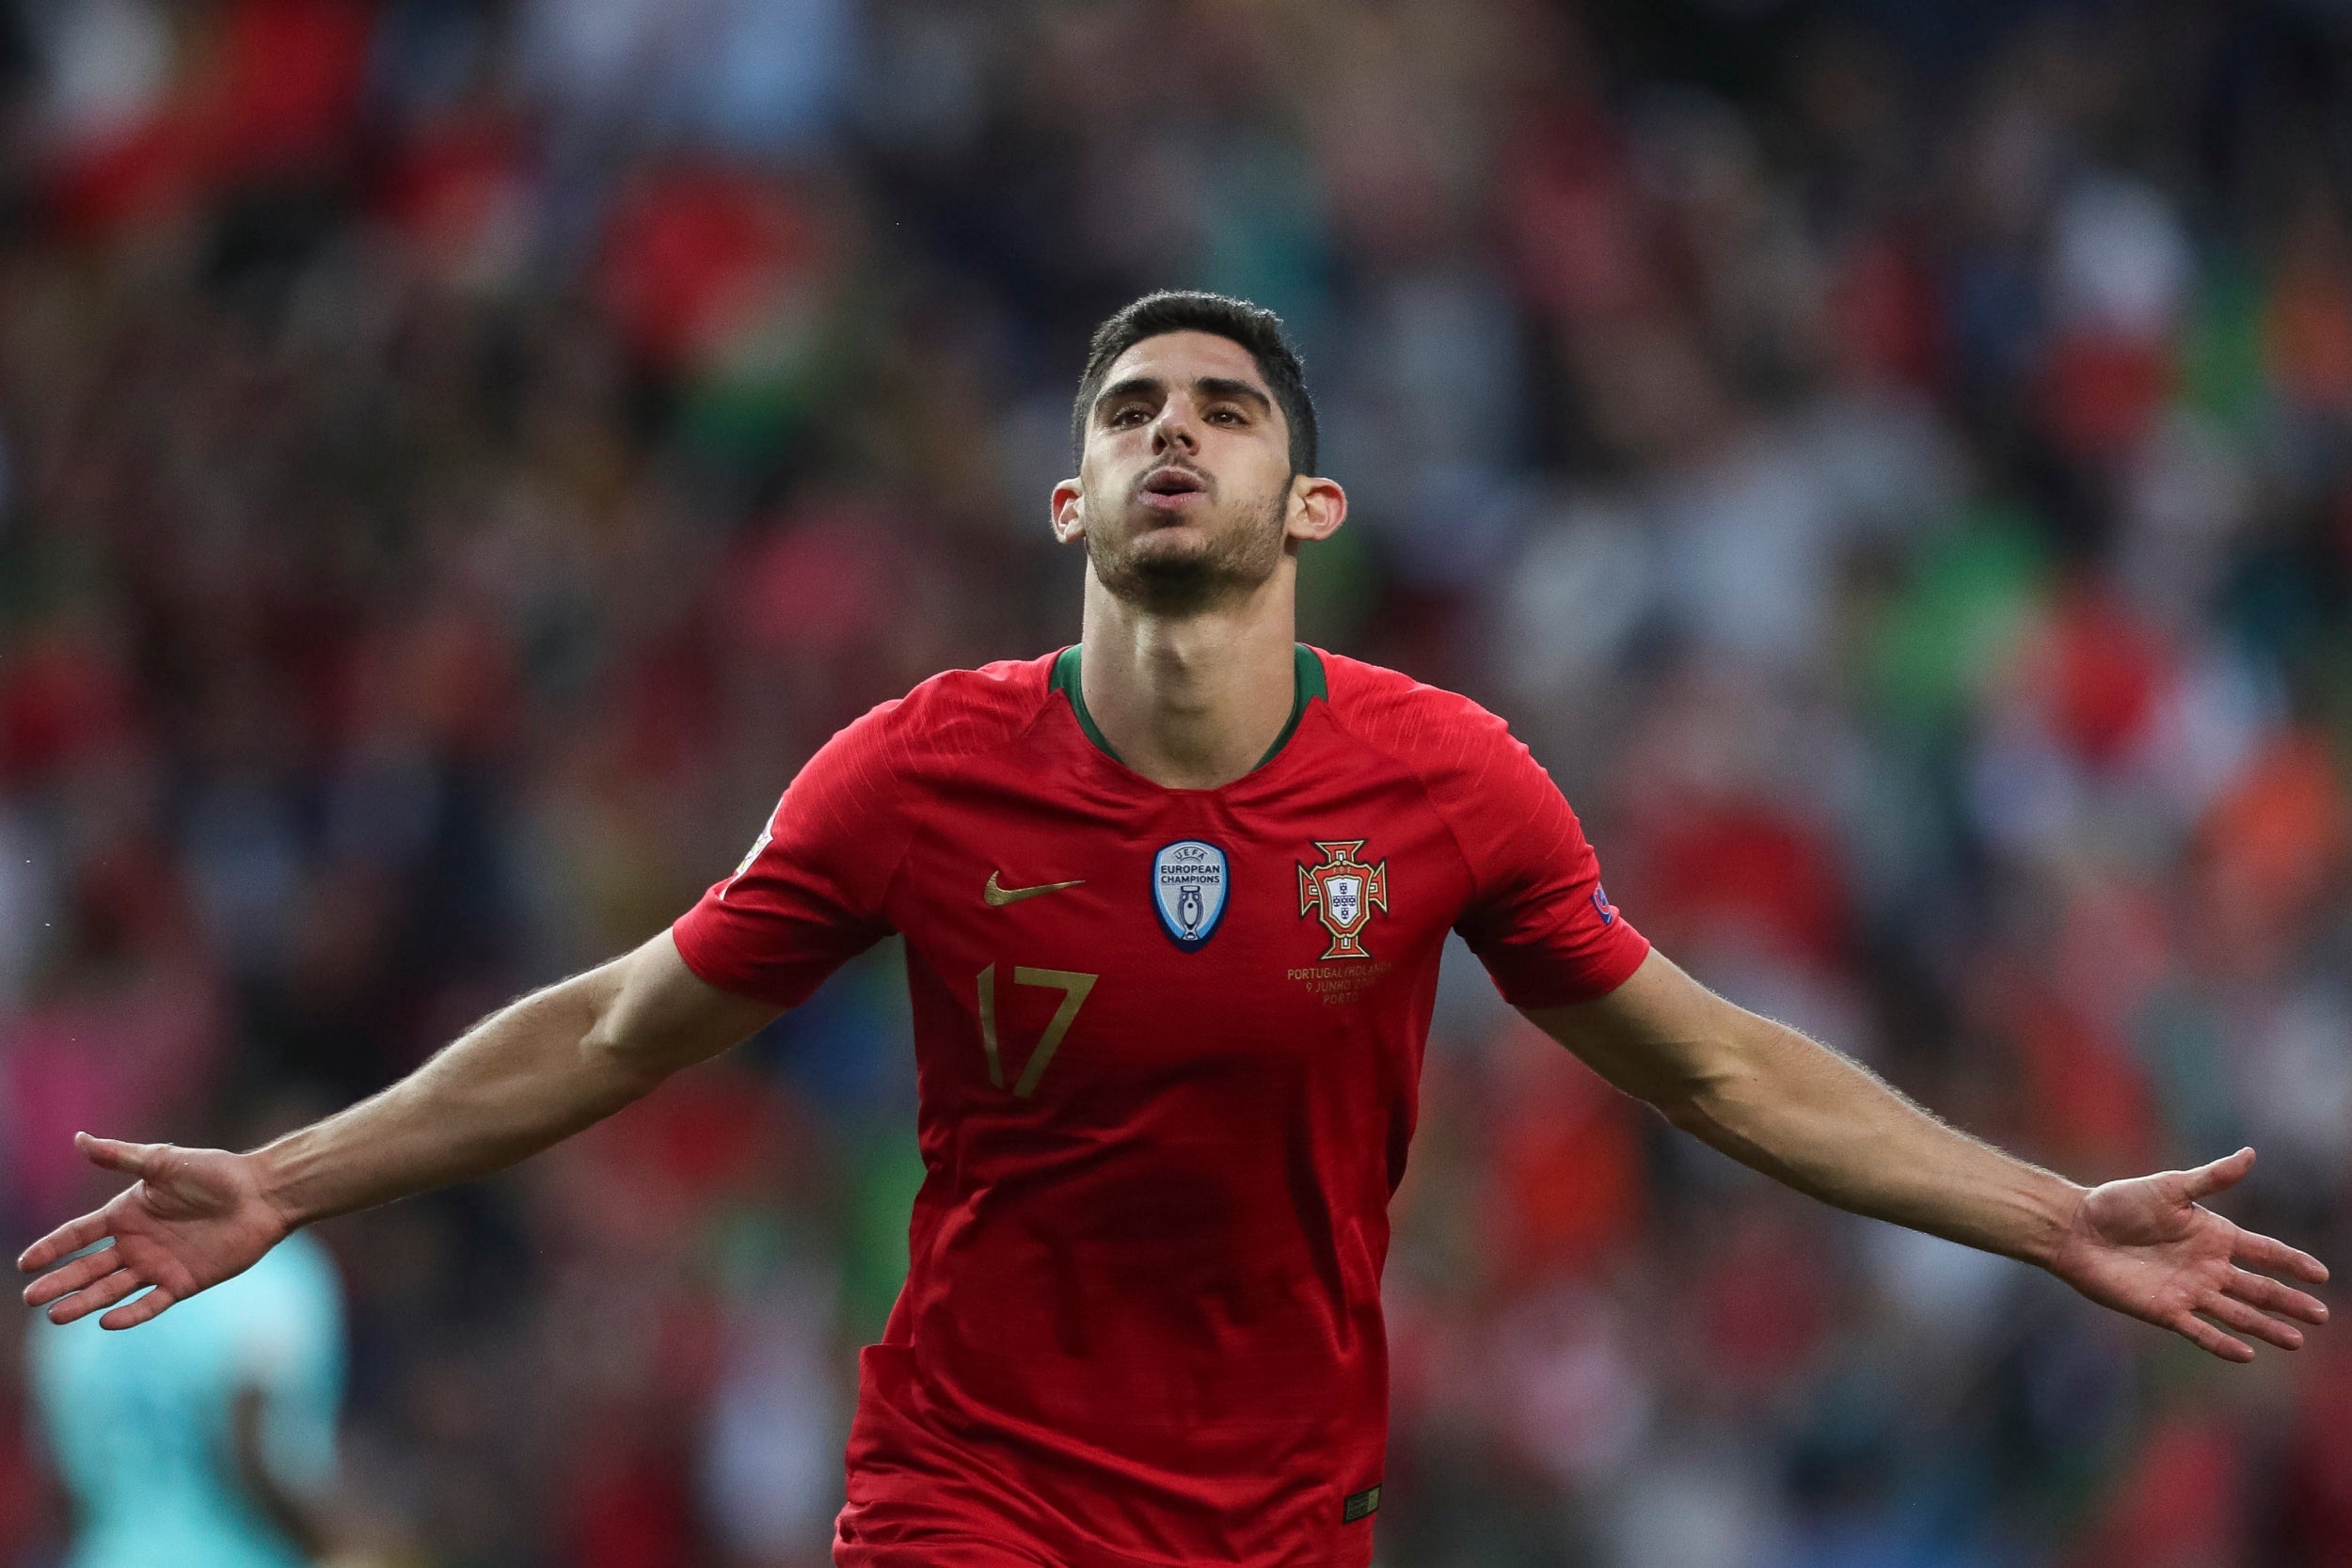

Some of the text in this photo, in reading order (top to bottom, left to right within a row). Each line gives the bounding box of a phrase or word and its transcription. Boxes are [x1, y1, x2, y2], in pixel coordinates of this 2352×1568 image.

[1175, 848, 1204, 860] UEFA
[1161, 864, 1220, 874] EUROPEAN
[1161, 875, 1220, 883] CHAMPIONS
[1306, 982, 1313, 992] 9
[1315, 980, 1351, 992] JUNHO
[1323, 990, 1359, 1005] PORTO
[976, 961, 1099, 1098] 17
